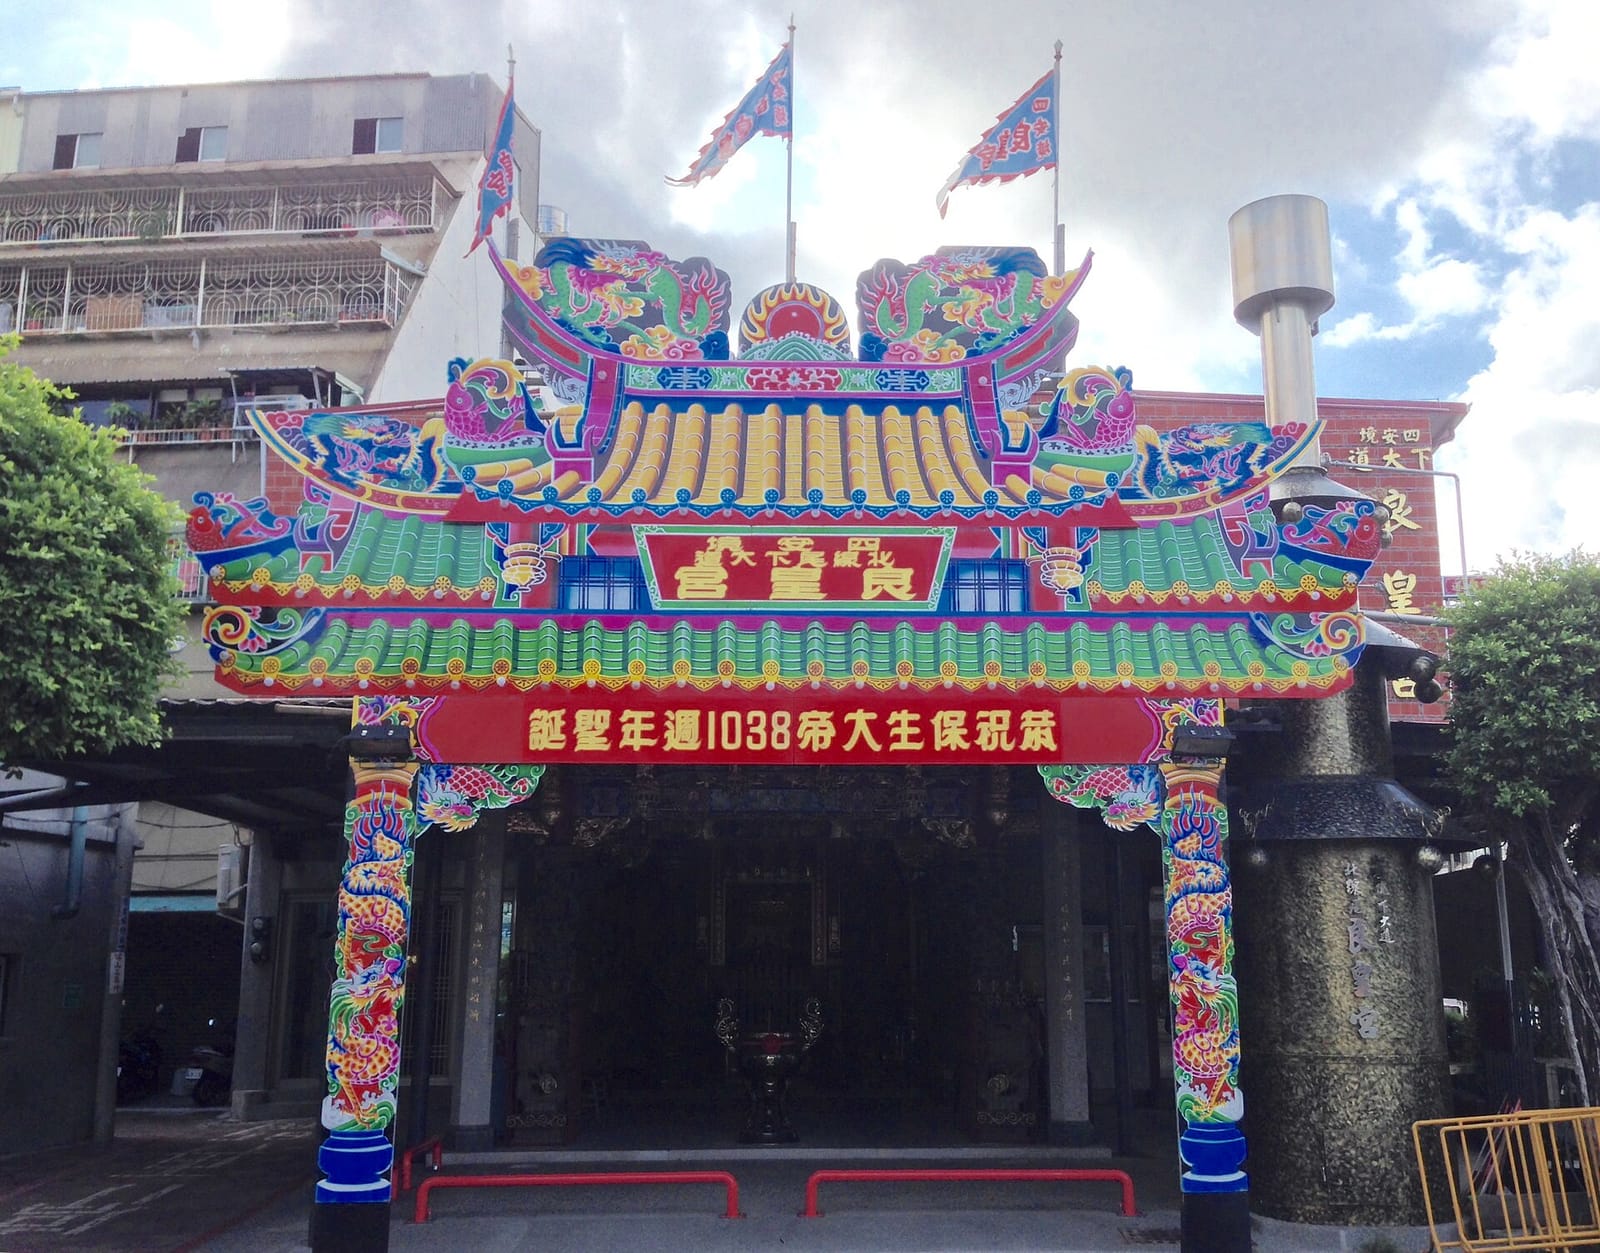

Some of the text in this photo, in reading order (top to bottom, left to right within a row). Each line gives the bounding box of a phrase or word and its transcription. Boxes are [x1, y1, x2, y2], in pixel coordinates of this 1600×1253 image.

[1359, 425, 1420, 446] 四安境
[1347, 446, 1431, 472] 下大道
[674, 565, 917, 601] 良皇宮
